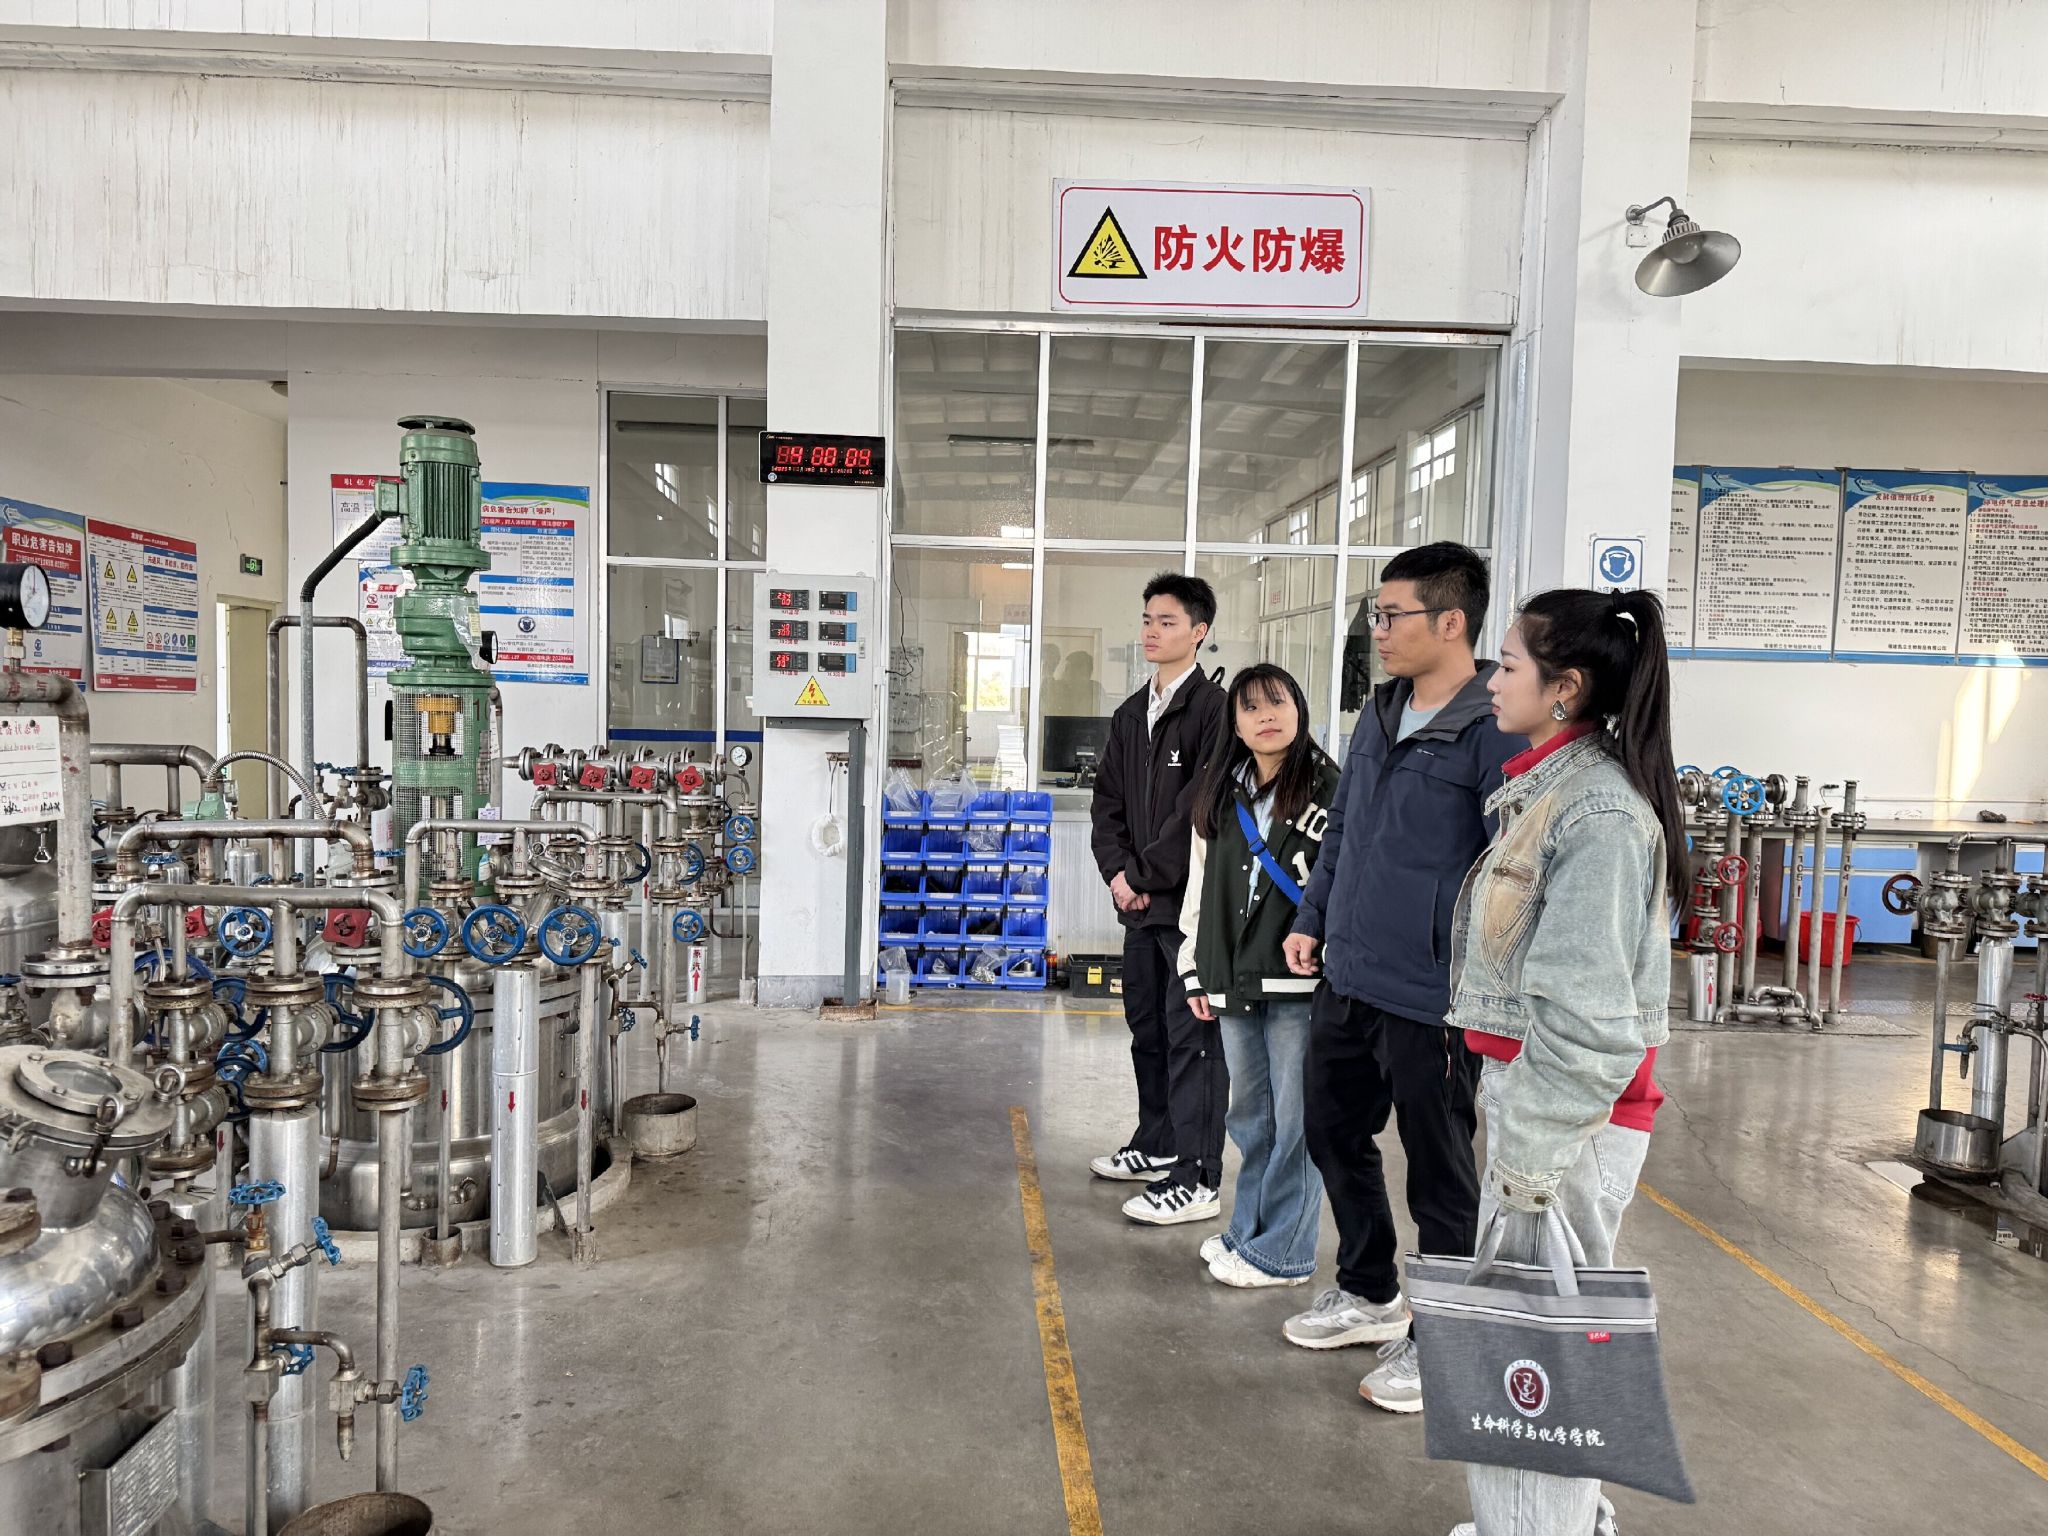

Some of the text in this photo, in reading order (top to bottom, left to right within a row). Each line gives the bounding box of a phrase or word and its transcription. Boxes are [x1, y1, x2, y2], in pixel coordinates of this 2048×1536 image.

[1153, 224, 1346, 275] 防火防爆
[12, 532, 73, 556] 职业危害告知牌
[1471, 1413, 1606, 1447] 生命科学与化学学院
